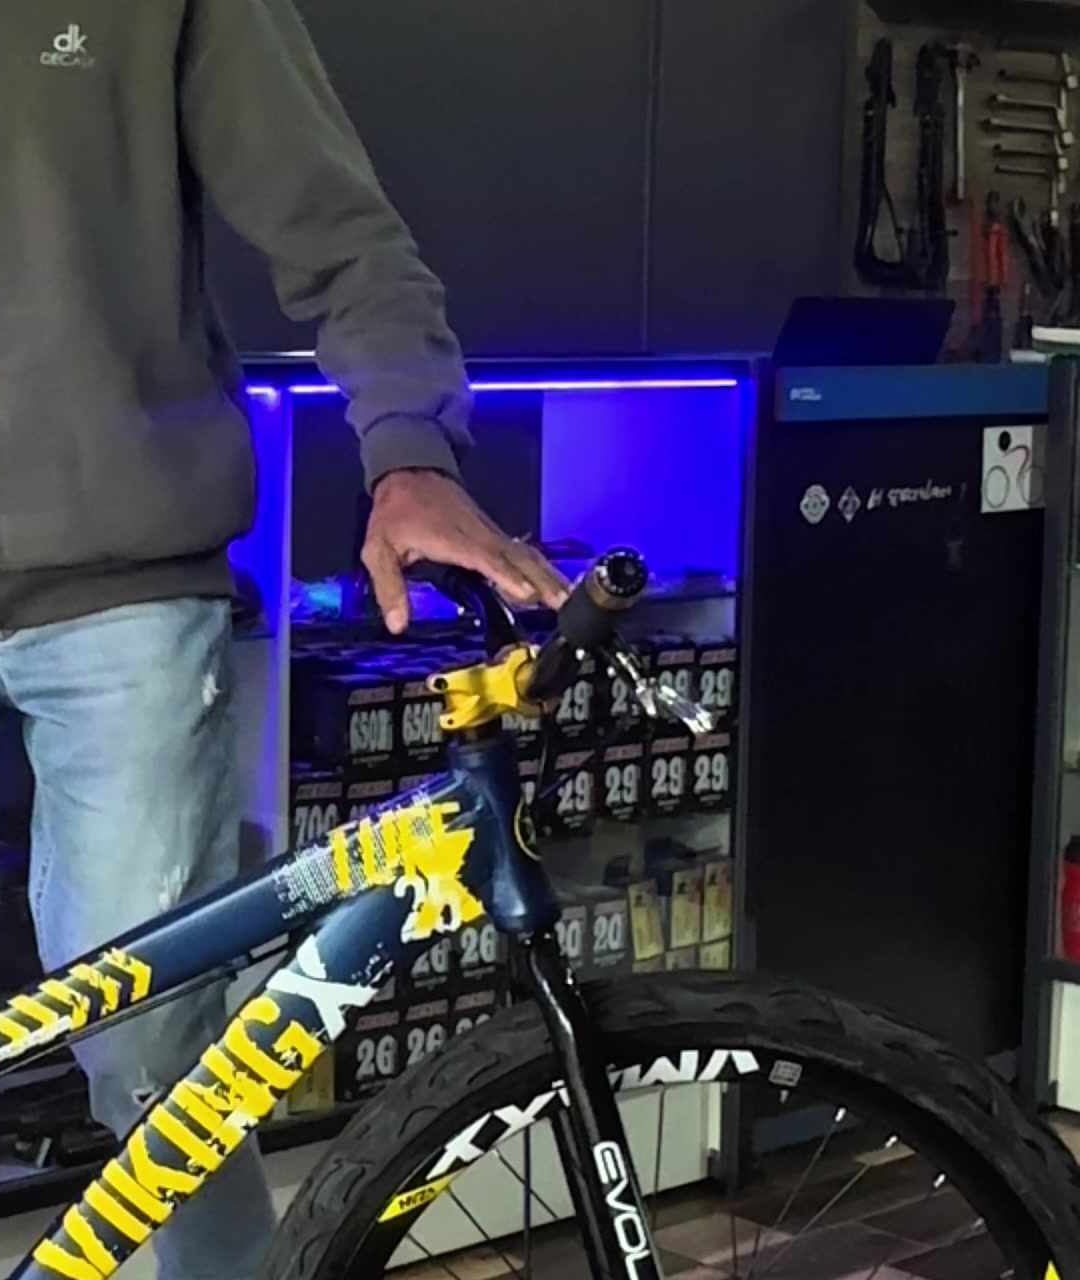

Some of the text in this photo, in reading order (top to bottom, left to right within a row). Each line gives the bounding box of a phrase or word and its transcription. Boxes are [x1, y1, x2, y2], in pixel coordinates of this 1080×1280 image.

[700, 668, 733, 712] 29
[557, 771, 593, 816] 29
[606, 764, 639, 808] 29
[652, 756, 686, 800] 29
[694, 753, 728, 794] 29
[460, 924, 498, 967] 26
[356, 1034, 397, 1081] 26
